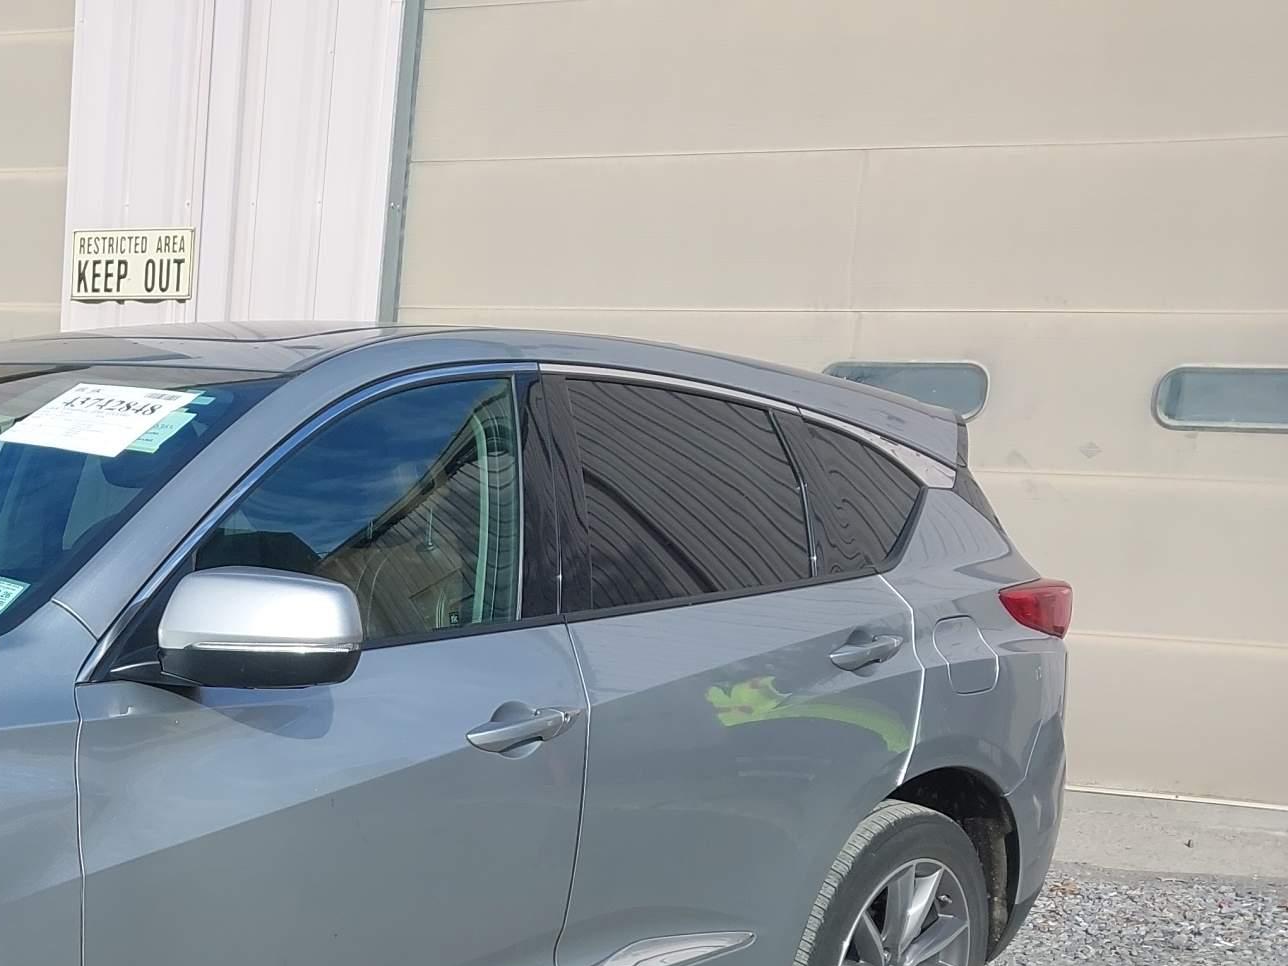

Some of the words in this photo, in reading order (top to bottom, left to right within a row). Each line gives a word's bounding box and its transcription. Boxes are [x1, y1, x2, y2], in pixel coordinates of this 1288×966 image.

[79, 236, 147, 254] RESTRICTED
[156, 235, 185, 253] AREA
[77, 259, 128, 293] KEEP
[144, 258, 185, 293] OUT
[63, 396, 163, 416] 43742848
